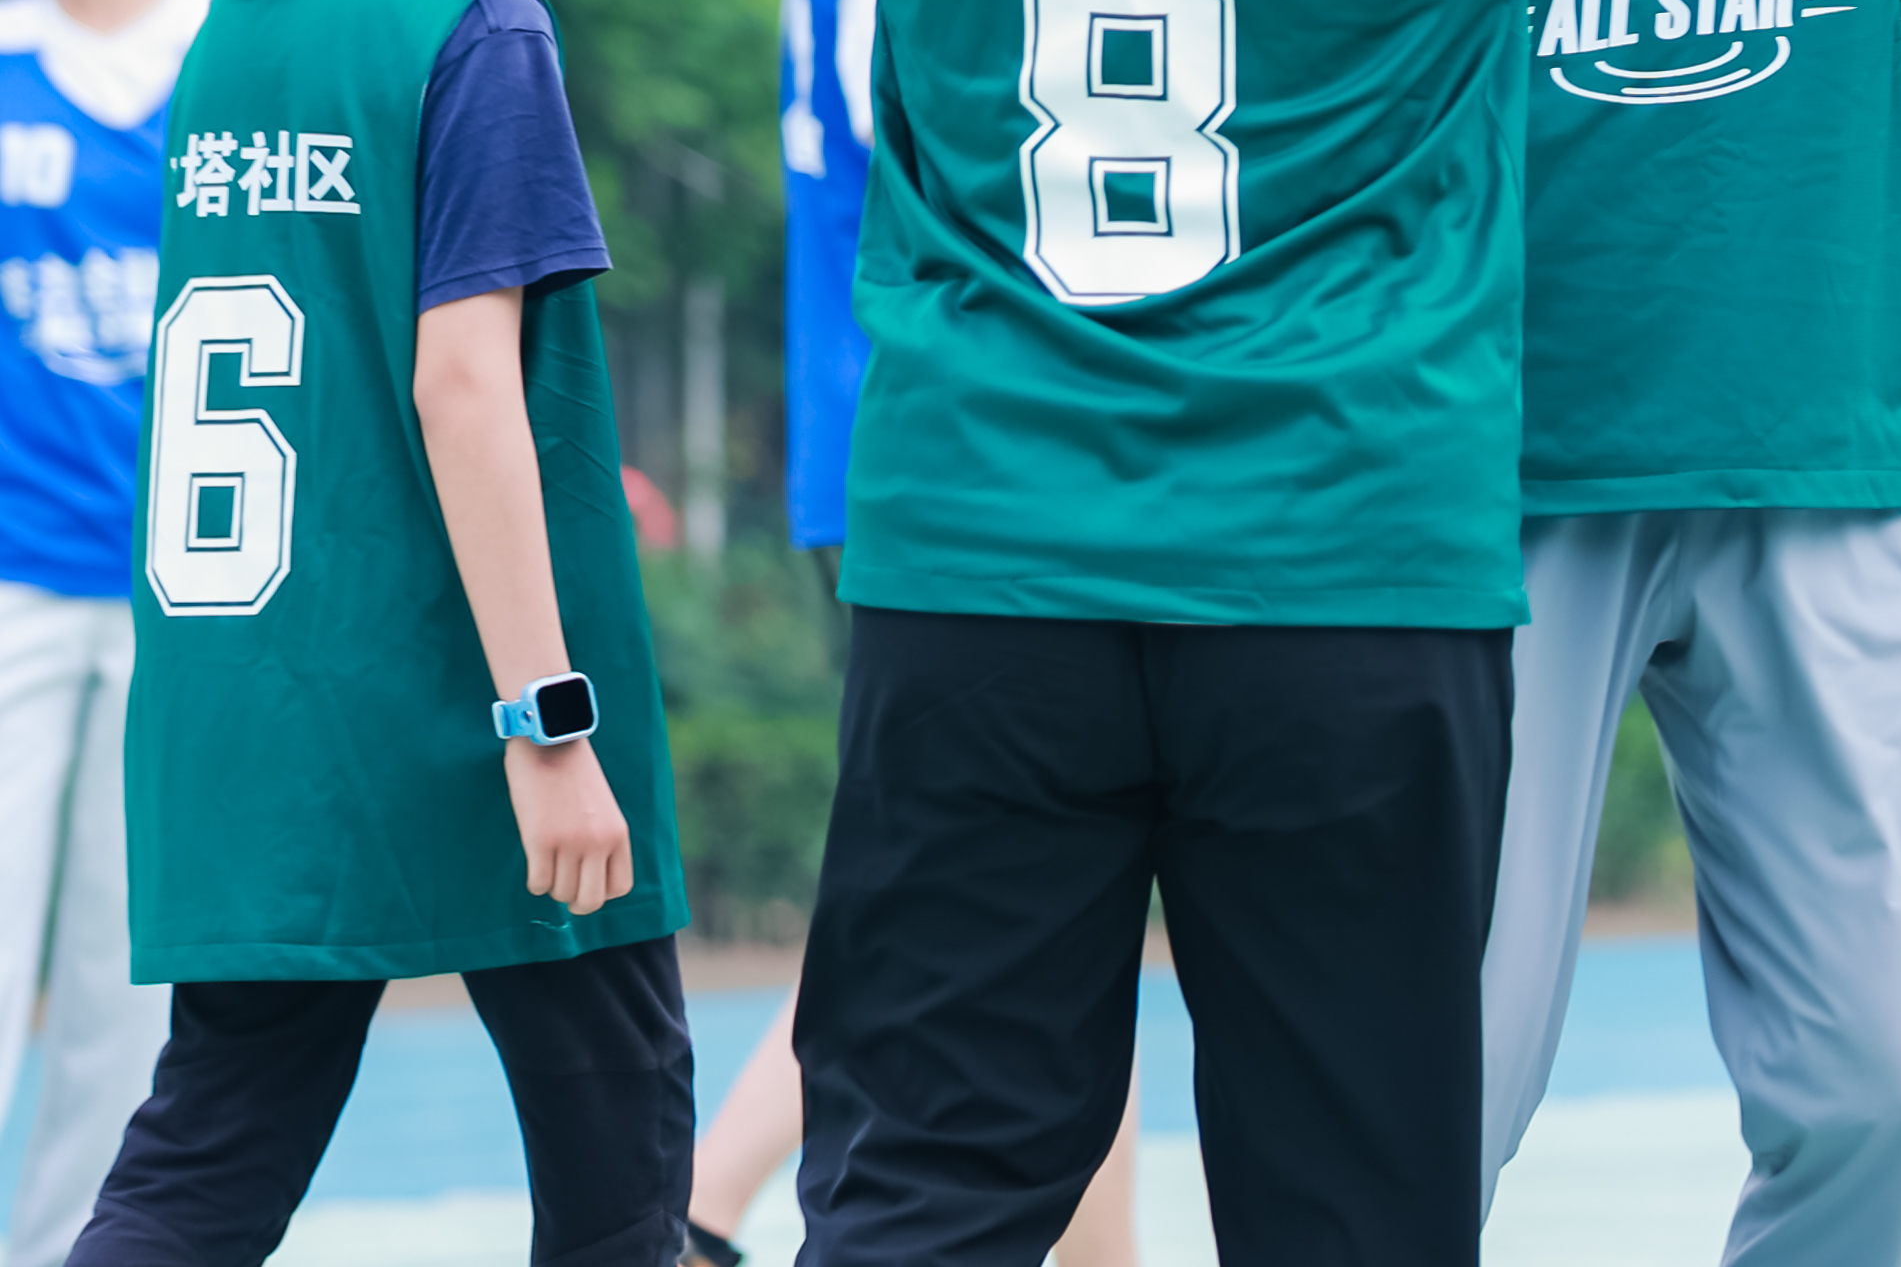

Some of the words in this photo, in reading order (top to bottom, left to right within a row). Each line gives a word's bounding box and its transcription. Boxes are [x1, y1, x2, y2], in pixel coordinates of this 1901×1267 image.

[170, 130, 361, 218] 塔社区
[145, 274, 305, 617] 6
